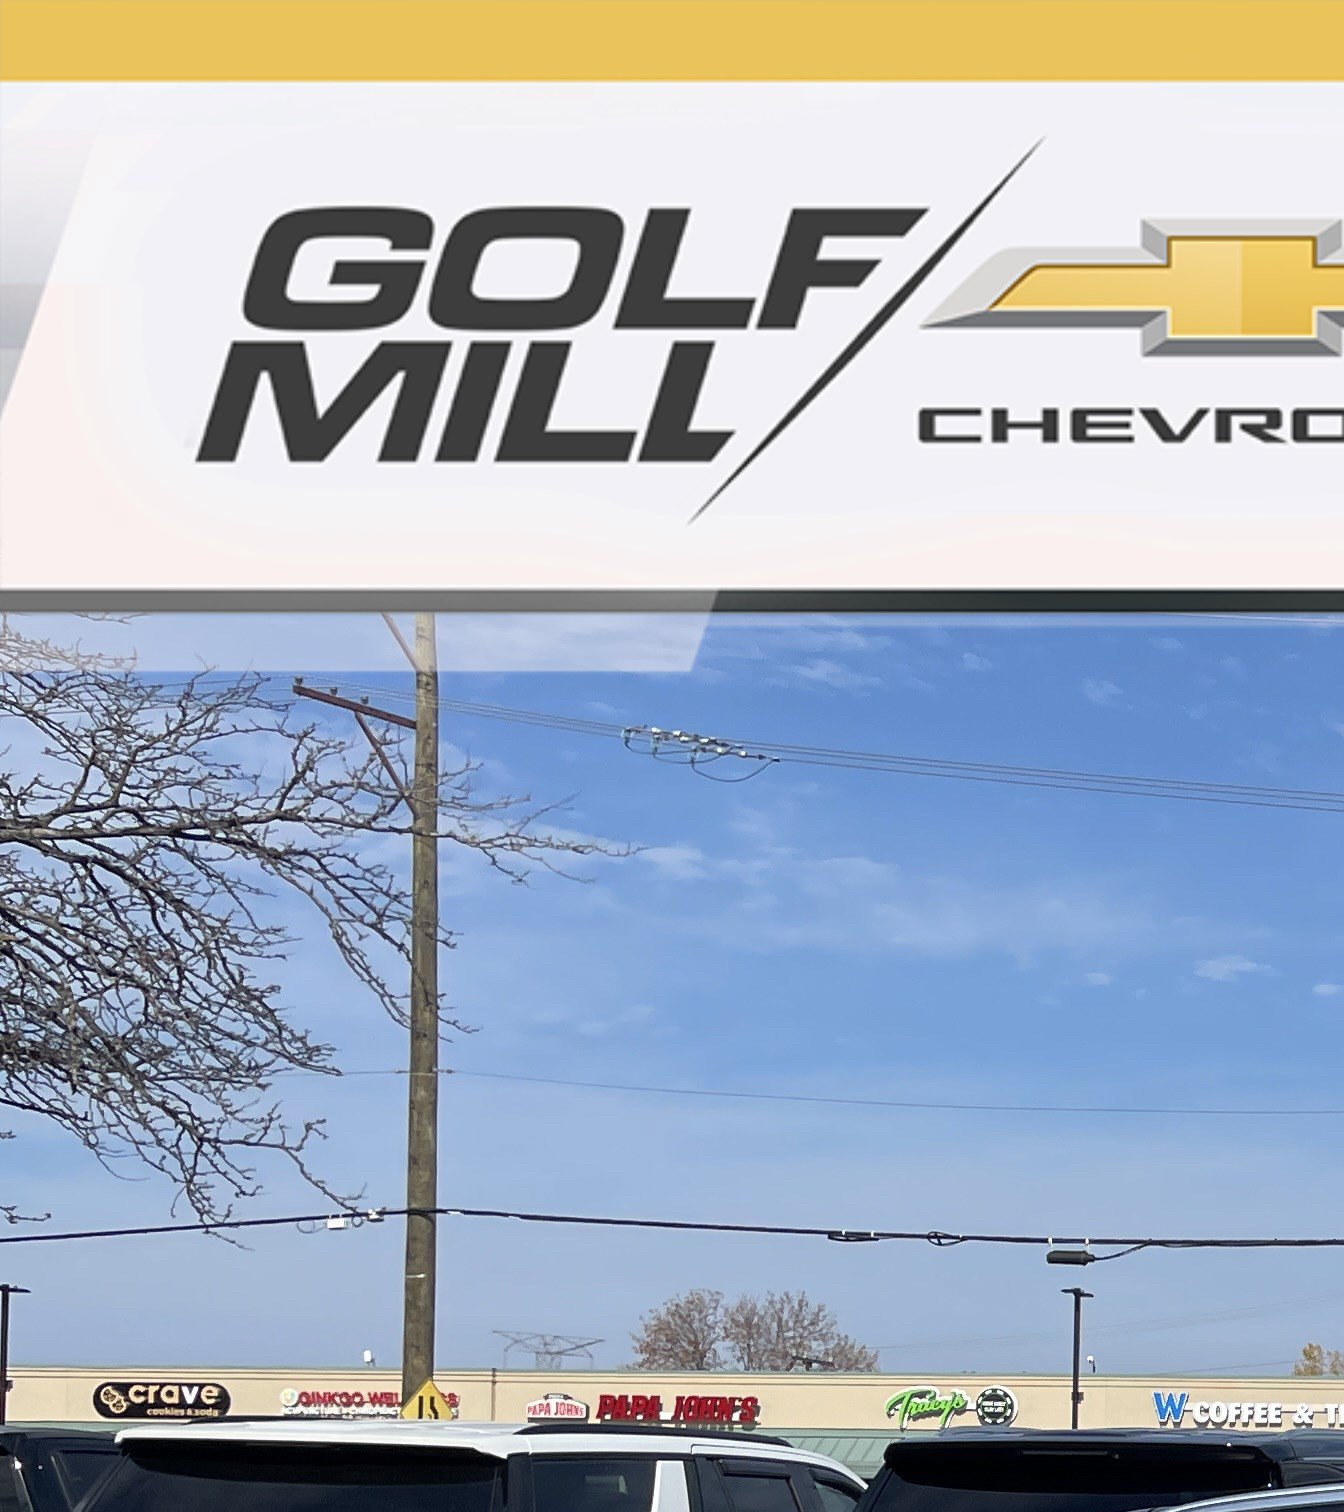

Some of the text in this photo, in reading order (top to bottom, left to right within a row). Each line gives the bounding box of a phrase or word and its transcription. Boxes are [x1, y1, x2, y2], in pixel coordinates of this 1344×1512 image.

[128, 1384, 220, 1405] crave
[597, 1394, 661, 1420] PAPA
[1153, 1392, 1188, 1422] W
[1193, 1401, 1283, 1426] COFFEE
[1293, 1402, 1313, 1425] &
